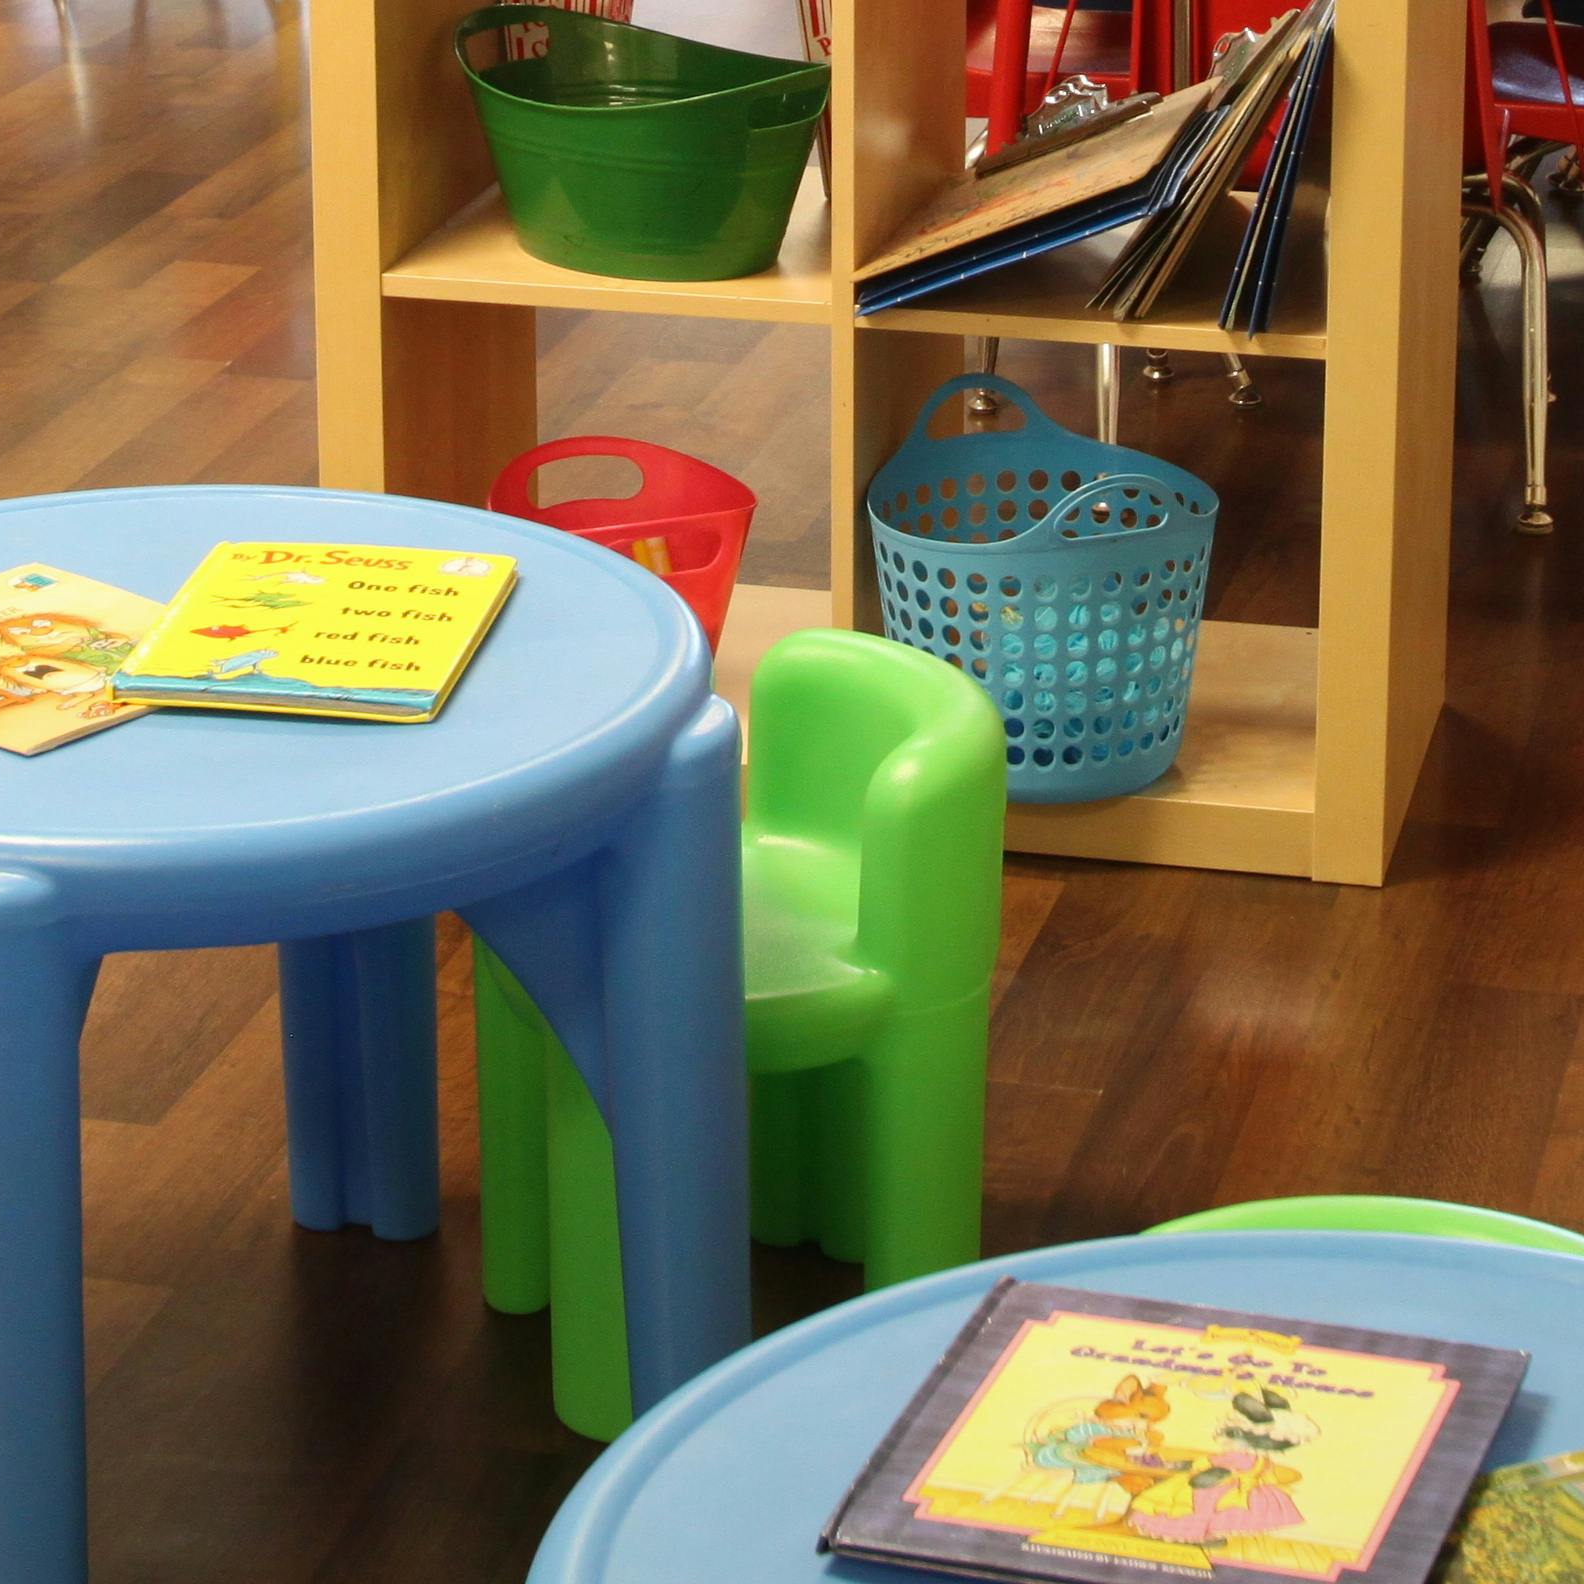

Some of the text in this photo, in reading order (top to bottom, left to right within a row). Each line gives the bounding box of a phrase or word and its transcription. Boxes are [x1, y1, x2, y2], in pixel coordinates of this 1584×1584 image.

[232, 550, 414, 571] By Dr. Seuss
[348, 581, 460, 597] One fish
[341, 606, 454, 623] two fish
[313, 630, 421, 646] red fish
[300, 654, 422, 672] blue fish
[1131, 1339, 1214, 1361] Let's
[1228, 1352, 1274, 1368] Go
[1292, 1361, 1327, 1376] To
[1071, 1346, 1375, 1399] Grandma's House
